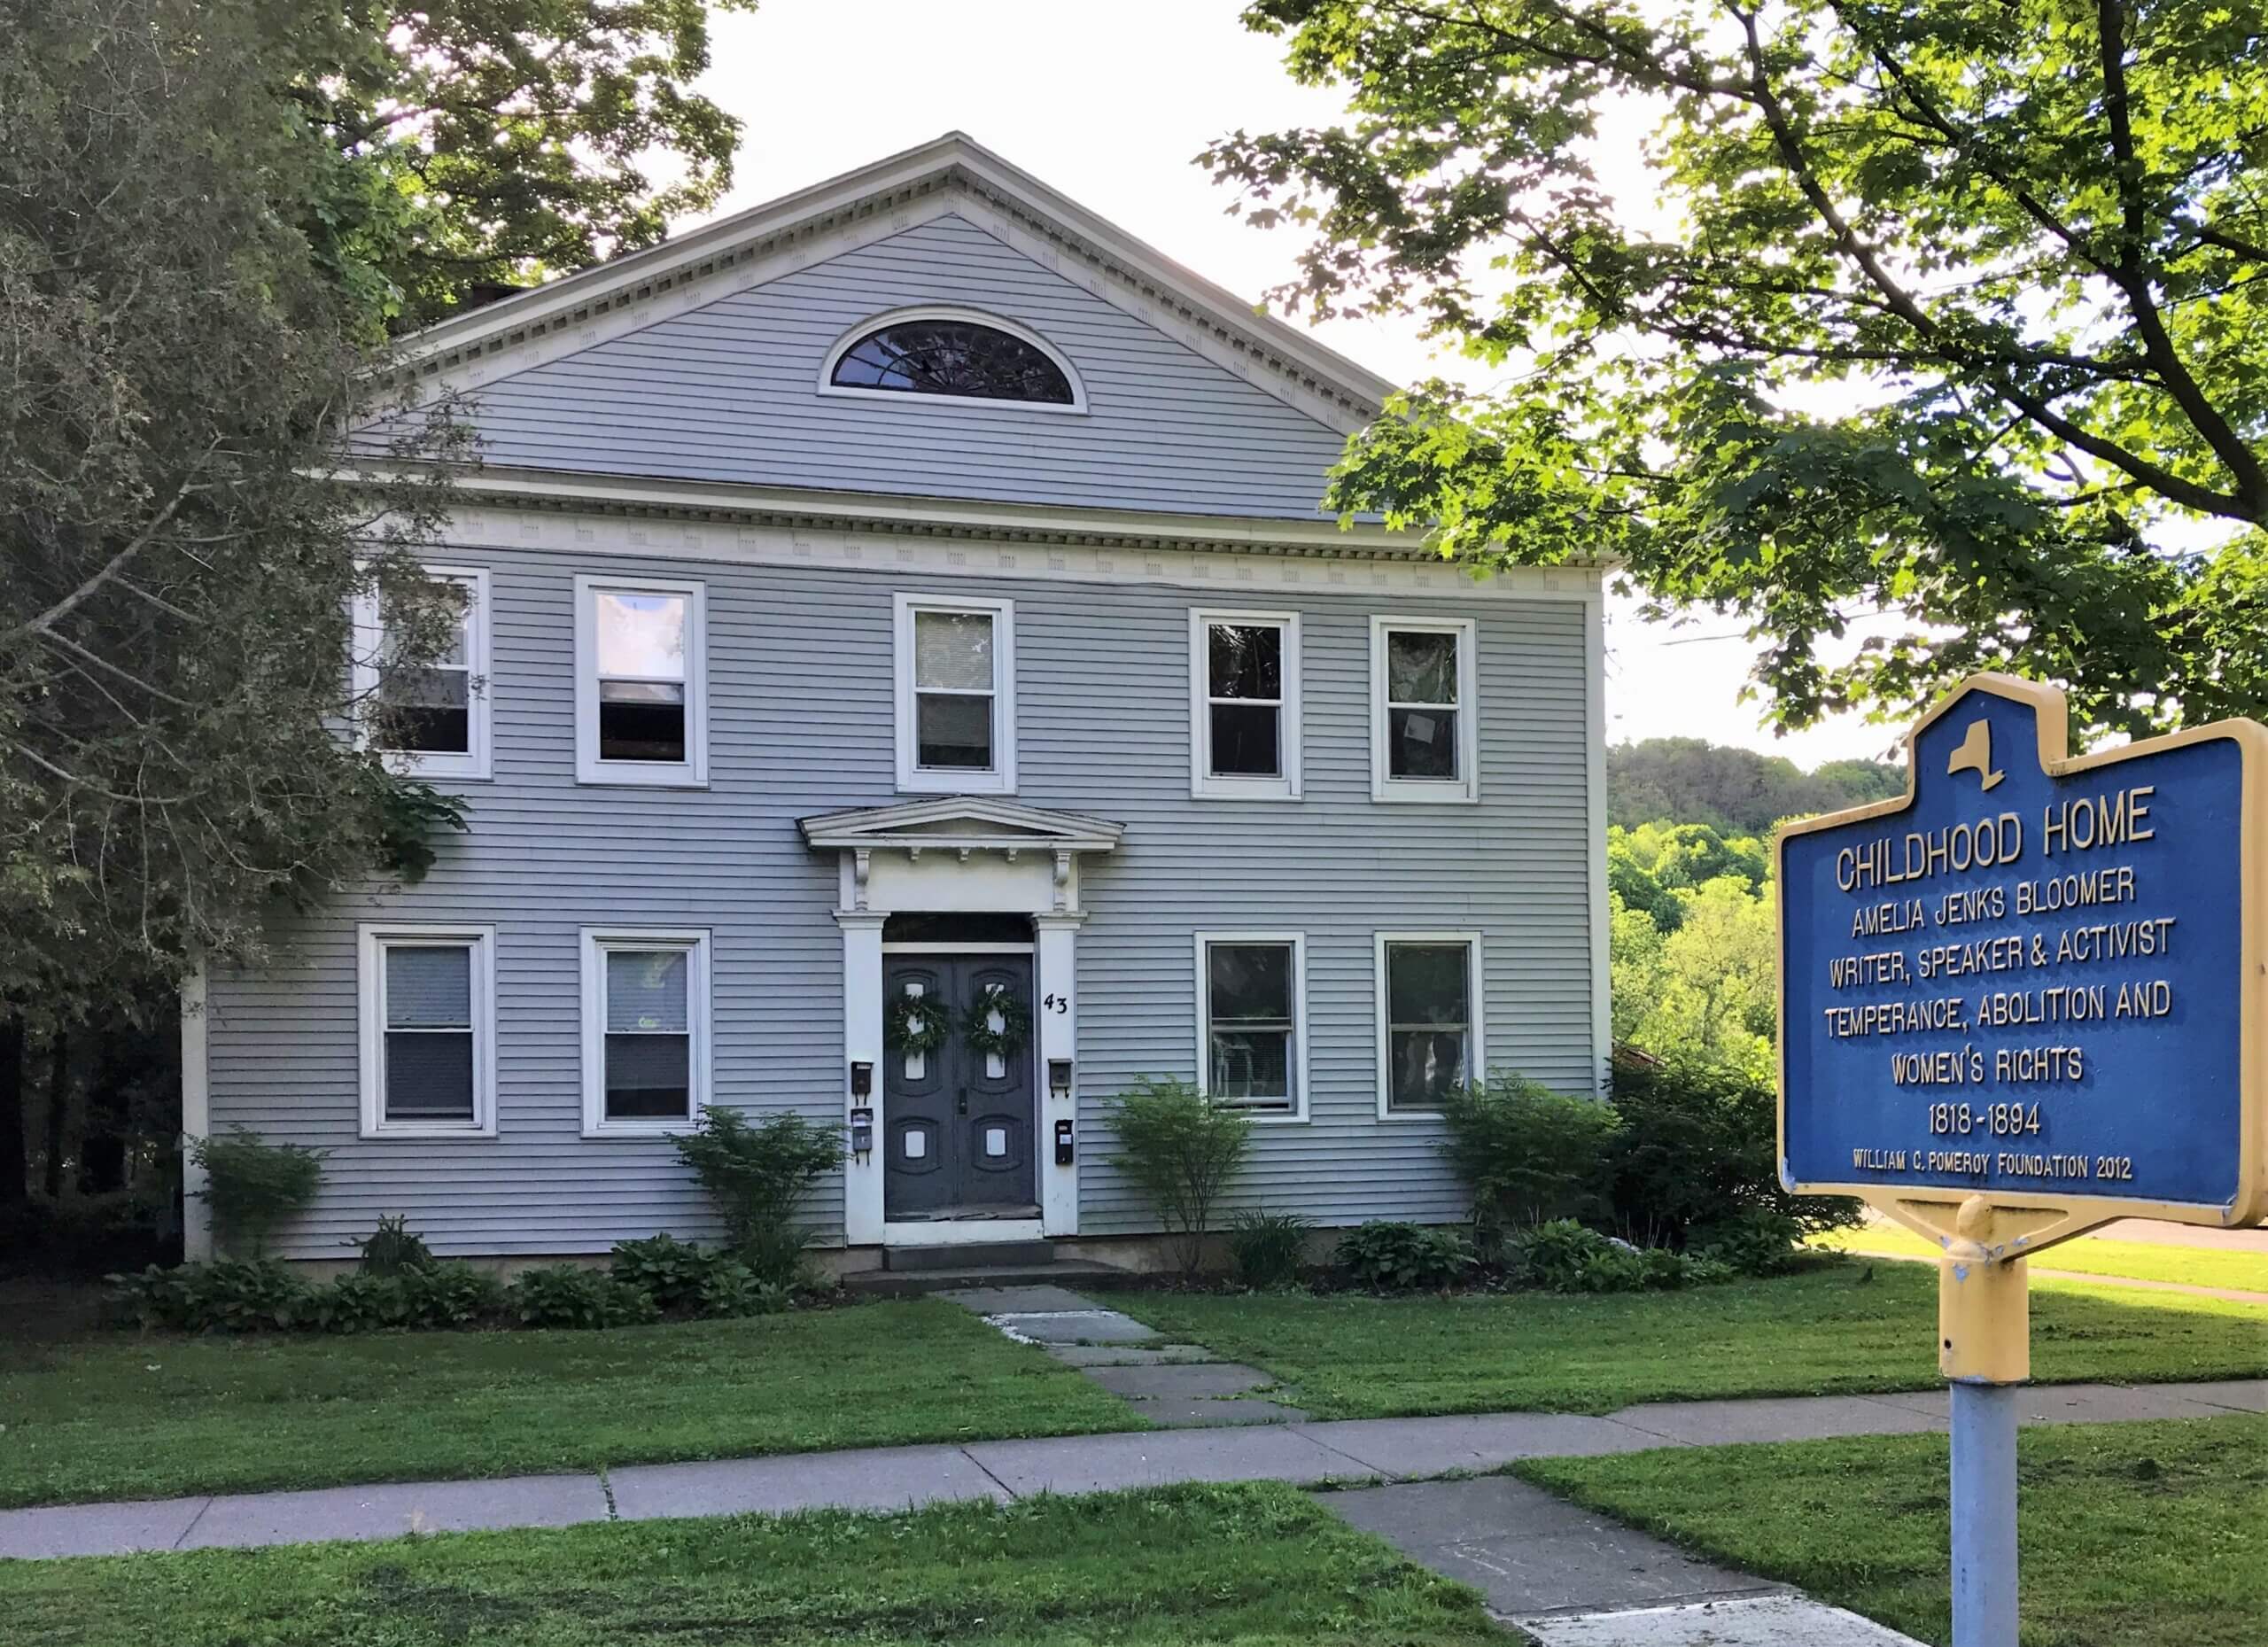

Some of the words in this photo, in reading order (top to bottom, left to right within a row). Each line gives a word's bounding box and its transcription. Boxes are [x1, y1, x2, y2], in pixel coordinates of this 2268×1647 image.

[1837, 812, 2023, 891] CHILDHOOD
[2044, 786, 2155, 856] HOME
[1852, 899, 1924, 937] AMELIA
[1935, 886, 2005, 927] JENKS
[2017, 866, 2135, 915] BLOOMER
[1829, 951, 1911, 988] WRITER,
[1918, 936, 2023, 978] SPEAKER
[2031, 933, 2047, 966] &
[2056, 917, 2176, 963] ACTIVIST
[1044, 993, 1068, 1014] 43
[1824, 998, 1969, 1037] TEMPERANCE,
[1977, 985, 2106, 1026] ABOLITION
[2115, 980, 2171, 1019] AND
[1891, 1043, 1984, 1084] WOMEN'S
[1995, 1047, 2085, 1082] RIGHTS
[1852, 1148, 1907, 1170] WILLIAM
[1929, 1153, 1991, 1174] POMEROY
[1998, 1153, 2089, 1178] FOUNDATION
[2096, 1156, 2133, 1179] 2012
